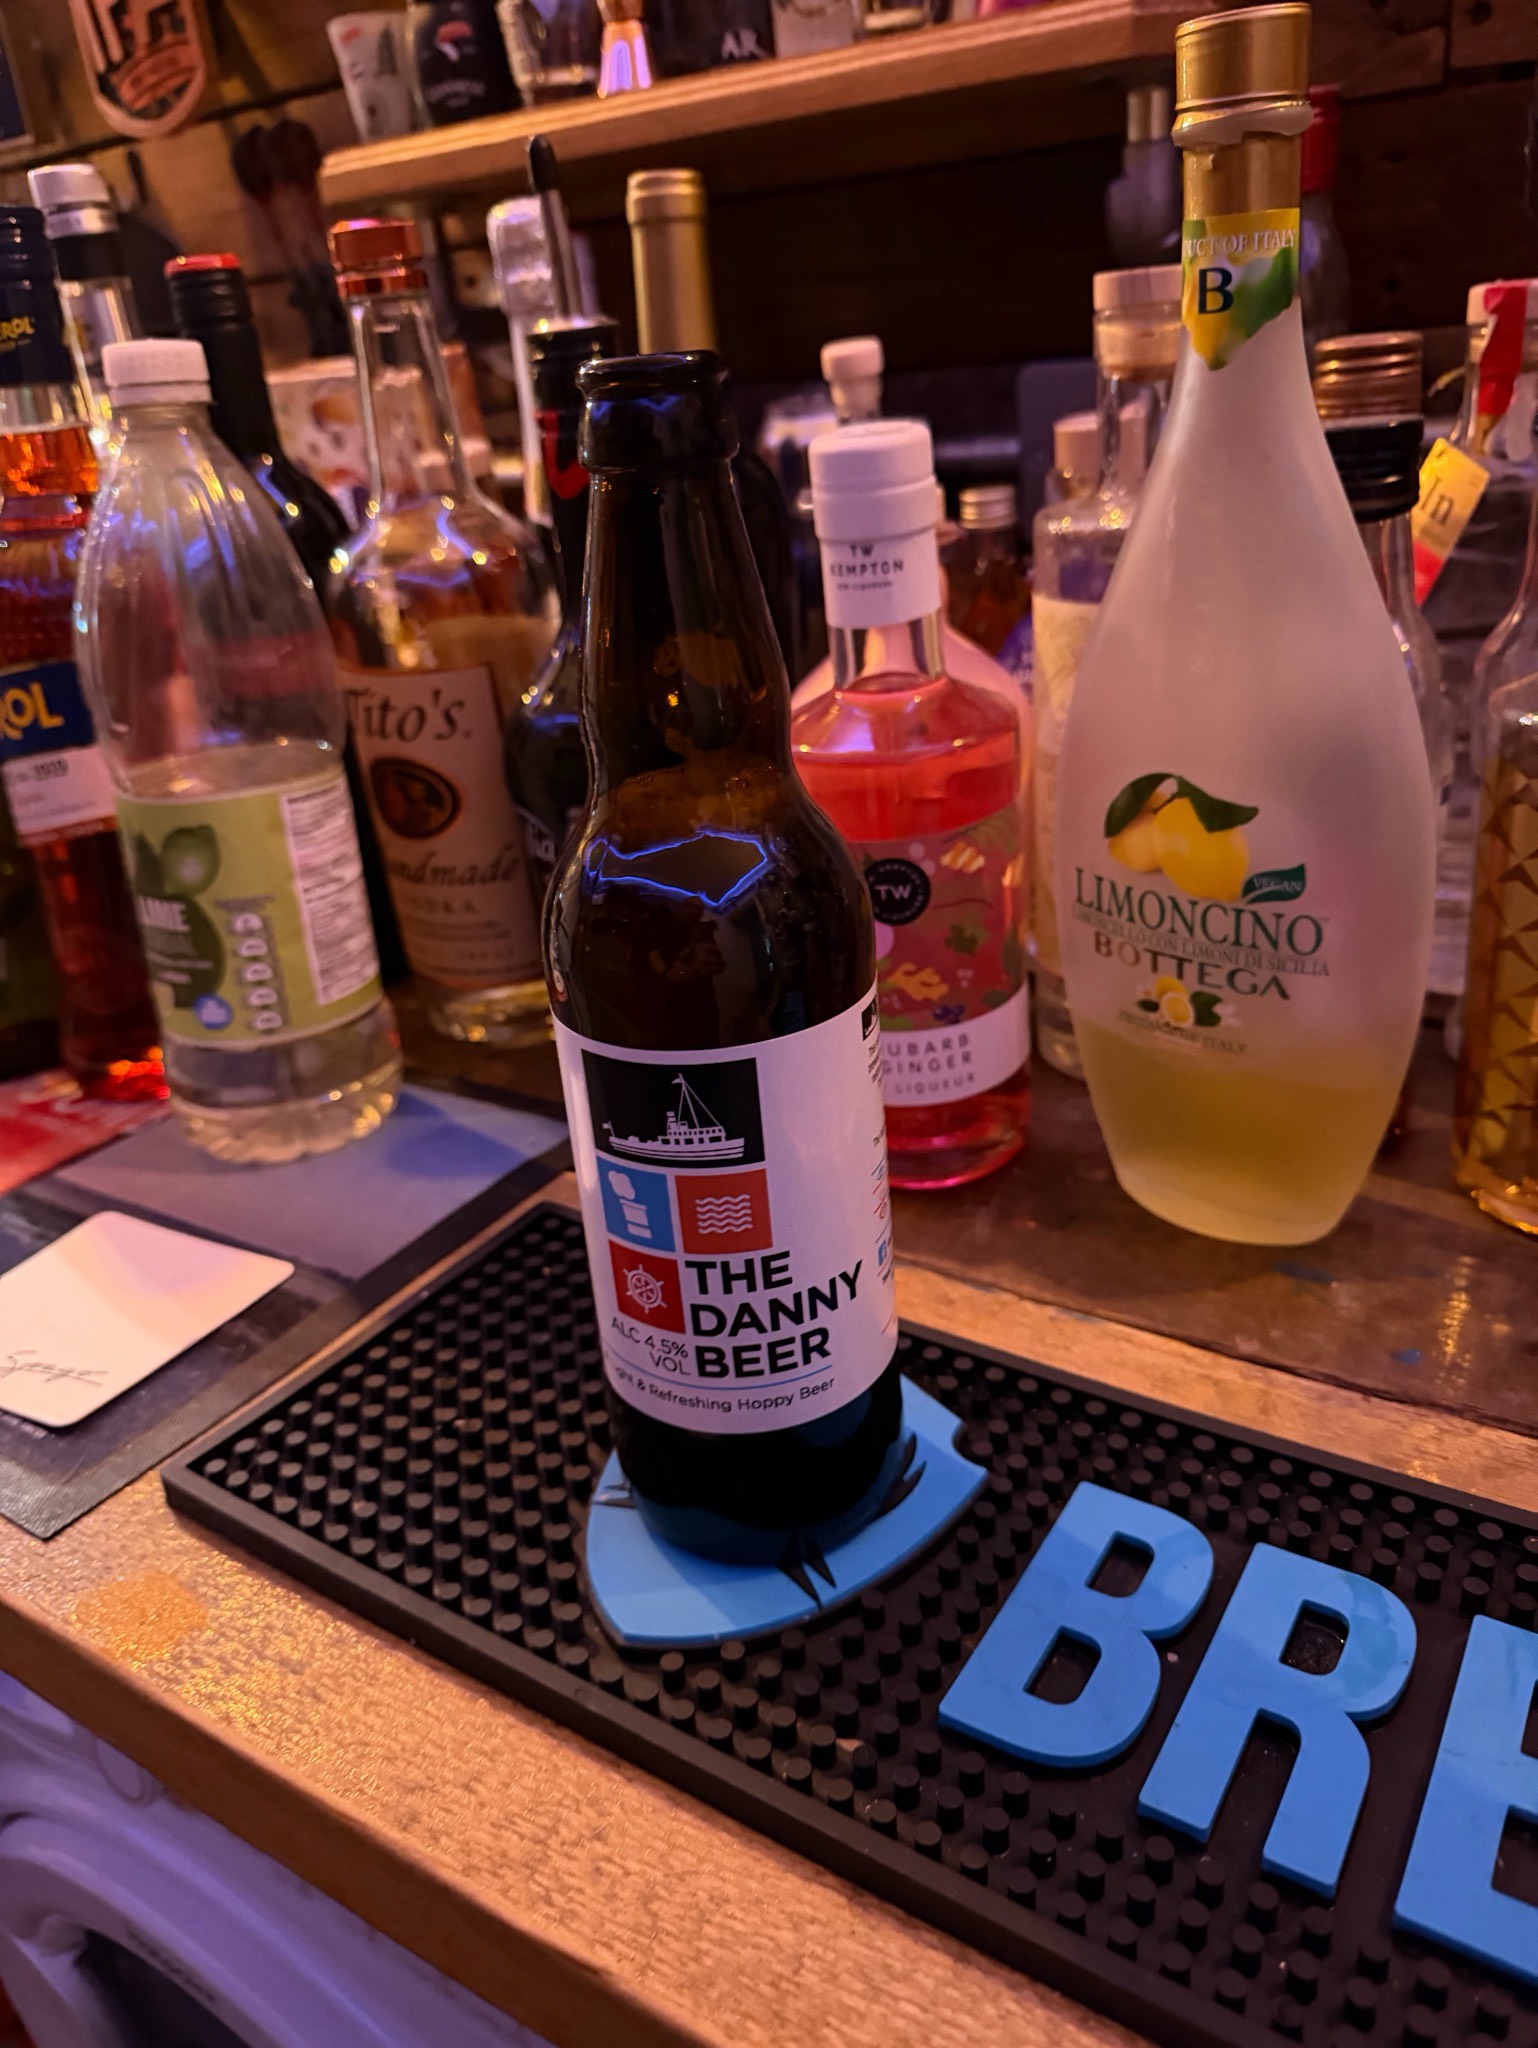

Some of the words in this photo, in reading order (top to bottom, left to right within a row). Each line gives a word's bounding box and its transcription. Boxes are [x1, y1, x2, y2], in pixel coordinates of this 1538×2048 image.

[1223, 233, 1248, 253] OF
[1254, 228, 1297, 250] ITALY
[1198, 267, 1234, 315] B
[849, 543, 874, 558] TW
[874, 883, 912, 901] TW
[1253, 877, 1300, 894] VEGAN
[1075, 866, 1323, 956] LIMONCINO
[1094, 930, 1291, 1000] BOTTEGA
[685, 1250, 792, 1296] THE
[690, 1259, 863, 1337] DANNY
[611, 1316, 641, 1344] ALC
[644, 1335, 689, 1359] 4.5%
[695, 1326, 831, 1379] BEER
[650, 1353, 692, 1376] VOL
[649, 1383, 732, 1413] Refreshing
[738, 1392, 794, 1412] Hoppy
[799, 1377, 836, 1401] Beer
